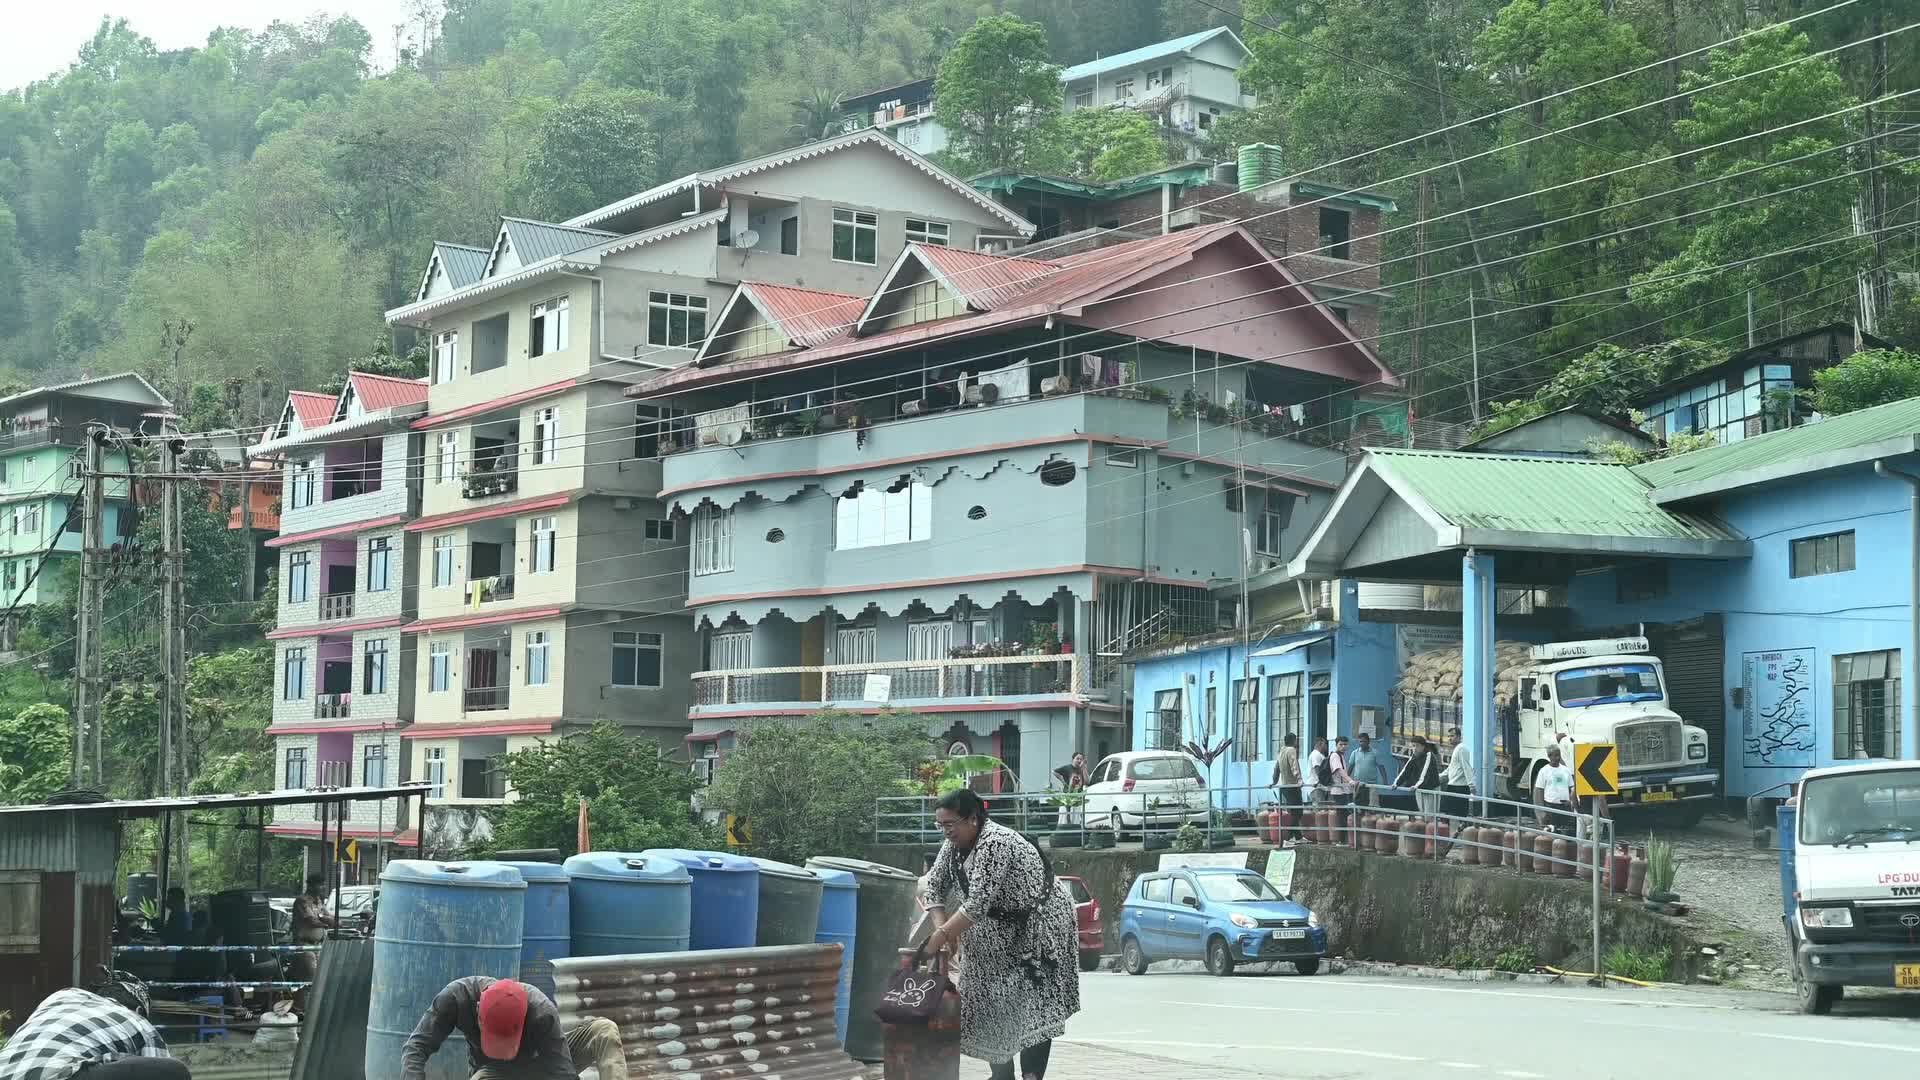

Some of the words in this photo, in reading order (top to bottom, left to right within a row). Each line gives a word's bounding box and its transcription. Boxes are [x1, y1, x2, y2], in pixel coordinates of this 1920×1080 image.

[1561, 647, 1586, 656] GOODS
[1616, 641, 1641, 651] CARRIER
[1768, 673, 1777, 681] MAP
[1878, 873, 1900, 884] LPG
[1902, 967, 1913, 976] SK
[1902, 976, 1920, 985] 006
